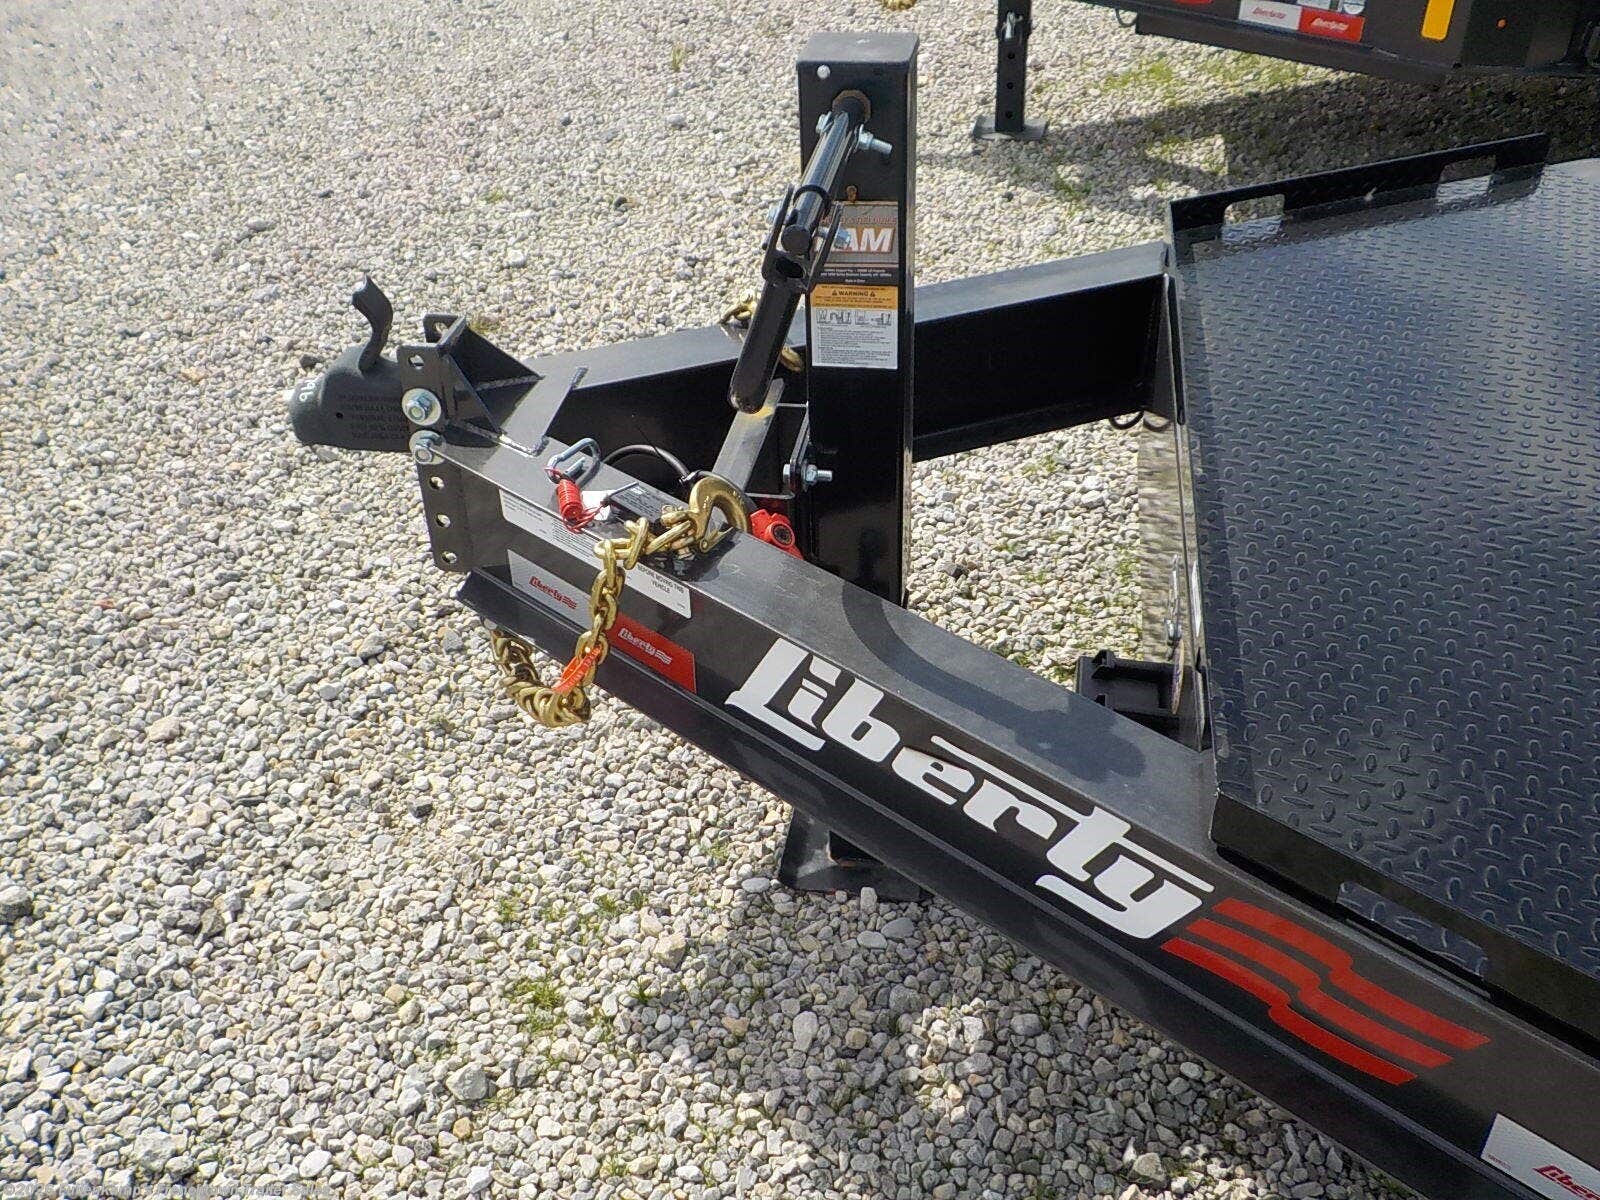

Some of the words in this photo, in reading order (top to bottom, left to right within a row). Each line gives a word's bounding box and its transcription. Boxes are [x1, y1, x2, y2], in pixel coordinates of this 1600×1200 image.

[528, 575, 563, 602] Liberty
[651, 580, 671, 594] VEHICLE
[617, 627, 656, 656] Liberty
[724, 637, 1215, 940] Liberty
